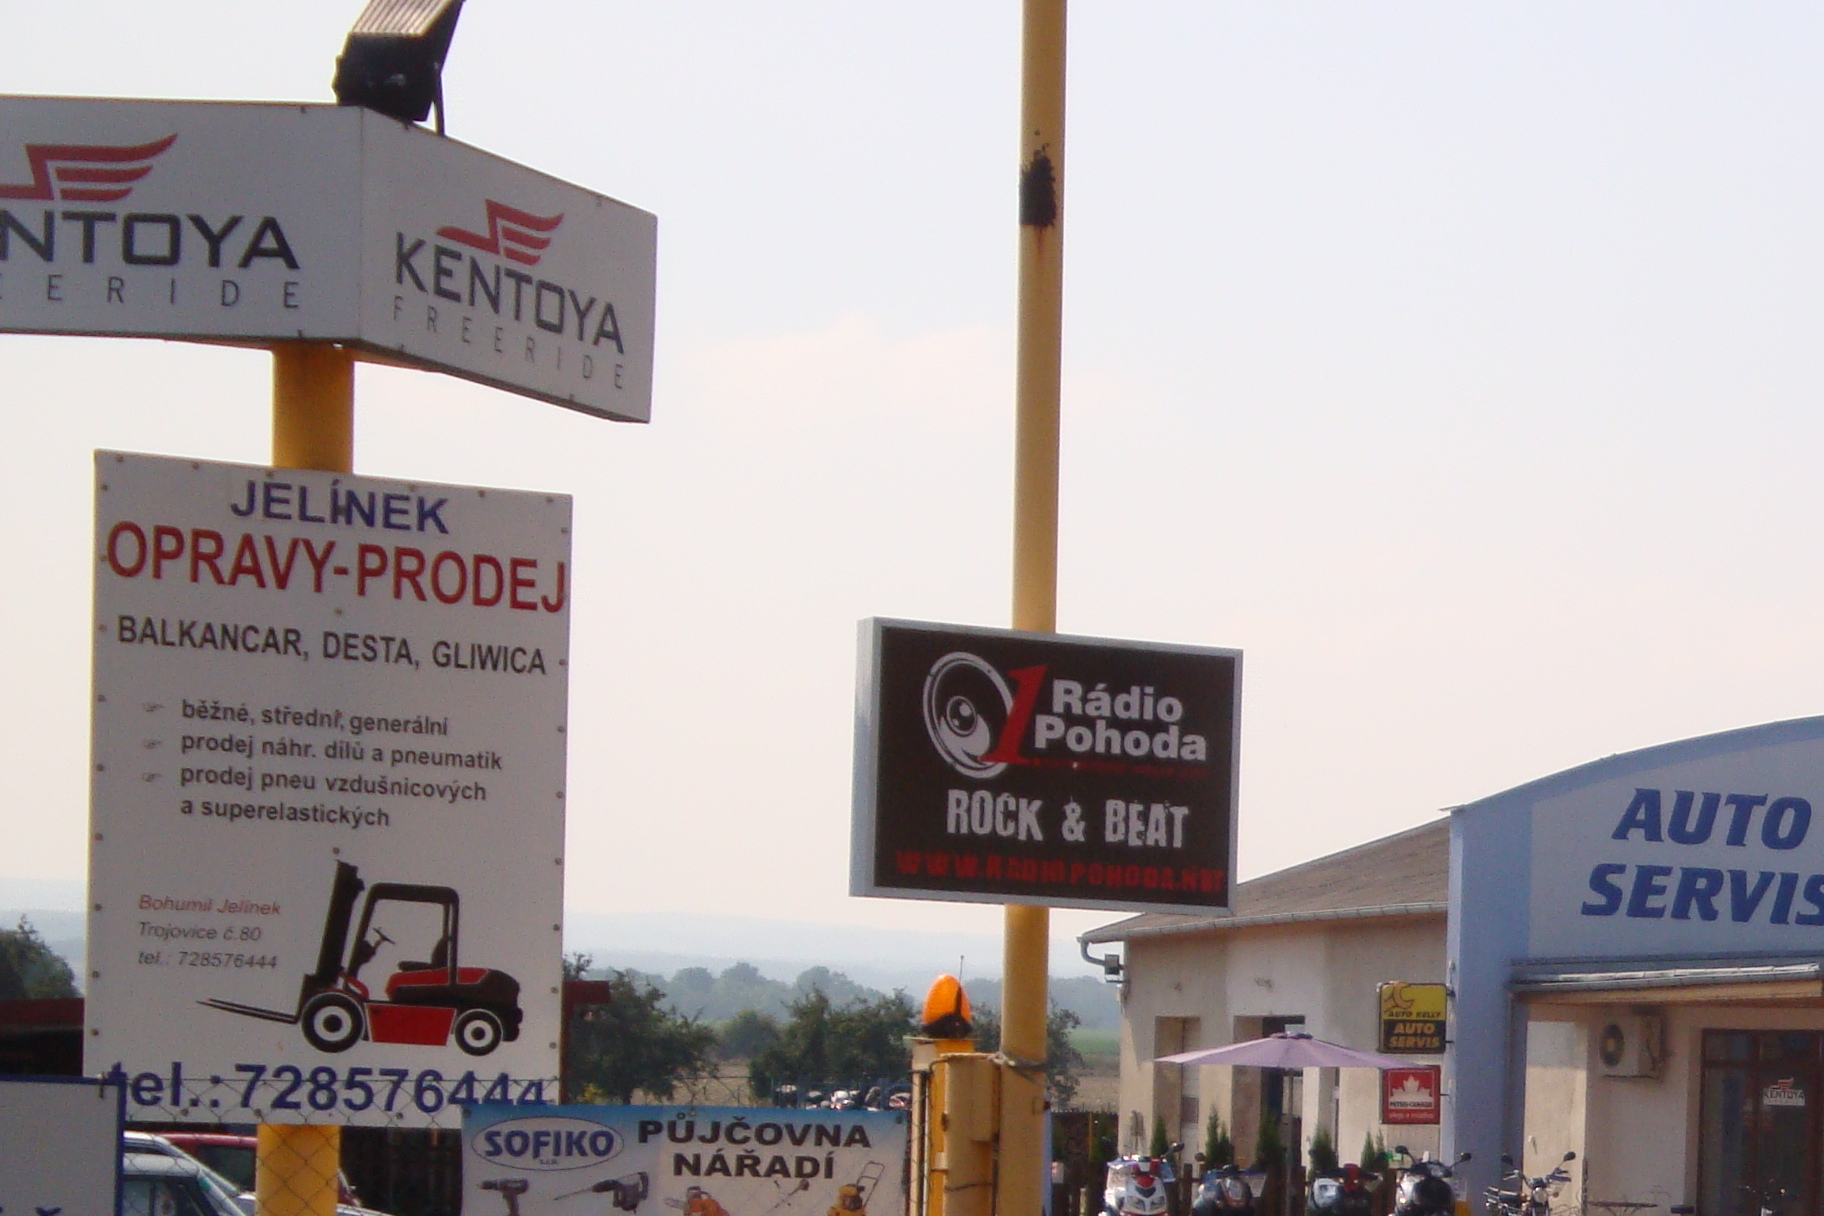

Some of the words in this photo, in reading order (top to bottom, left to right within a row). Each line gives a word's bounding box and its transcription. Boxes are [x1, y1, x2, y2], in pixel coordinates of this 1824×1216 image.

[396, 232, 625, 354] KENTOYA
[393, 295, 623, 389] FREERIDE
[231, 479, 449, 534] JELÍNEK
[106, 521, 566, 614] OPRAVY-PRODEJ
[118, 614, 309, 661] BALKANCAR,
[322, 631, 419, 669] DESTA,
[432, 641, 546, 675] GLIWICA
[181, 699, 255, 725] běžné,
[261, 707, 344, 731] střední,
[349, 713, 449, 736] generální
[1052, 678, 1184, 723] Rádio
[181, 734, 253, 758] prodej
[261, 739, 316, 758] náhr.
[324, 739, 364, 761] dílů
[371, 747, 384, 762] a
[390, 746, 502, 770] pneumatik
[1034, 715, 1207, 761] Pohoda
[181, 767, 253, 790] prodej
[261, 771, 315, 791] pneu
[325, 774, 487, 804] vzdušnicových
[181, 801, 192, 815] a
[201, 800, 389, 829] superelastických
[946, 788, 1044, 842] ROCK
[1062, 797, 1086, 843] &
[1105, 799, 1190, 849] BEAT
[1612, 788, 1813, 850] AUTO
[139, 894, 213, 912] Bohumil
[139, 922, 217, 941] Trojovice
[178, 951, 277, 968] 728576444
[1389, 1036, 1440, 1048] SERVIS
[1394, 1022, 1436, 1034] AUTO
[113, 1062, 219, 1107] tel.:
[235, 1063, 546, 1113] 728576444
[1763, 1089, 1805, 1099] KENTOYA
[484, 1129, 614, 1161] SOFIKO
[637, 1112, 871, 1149] PŮJČOVNA
[672, 1148, 835, 1180] NÁŘADÍ
